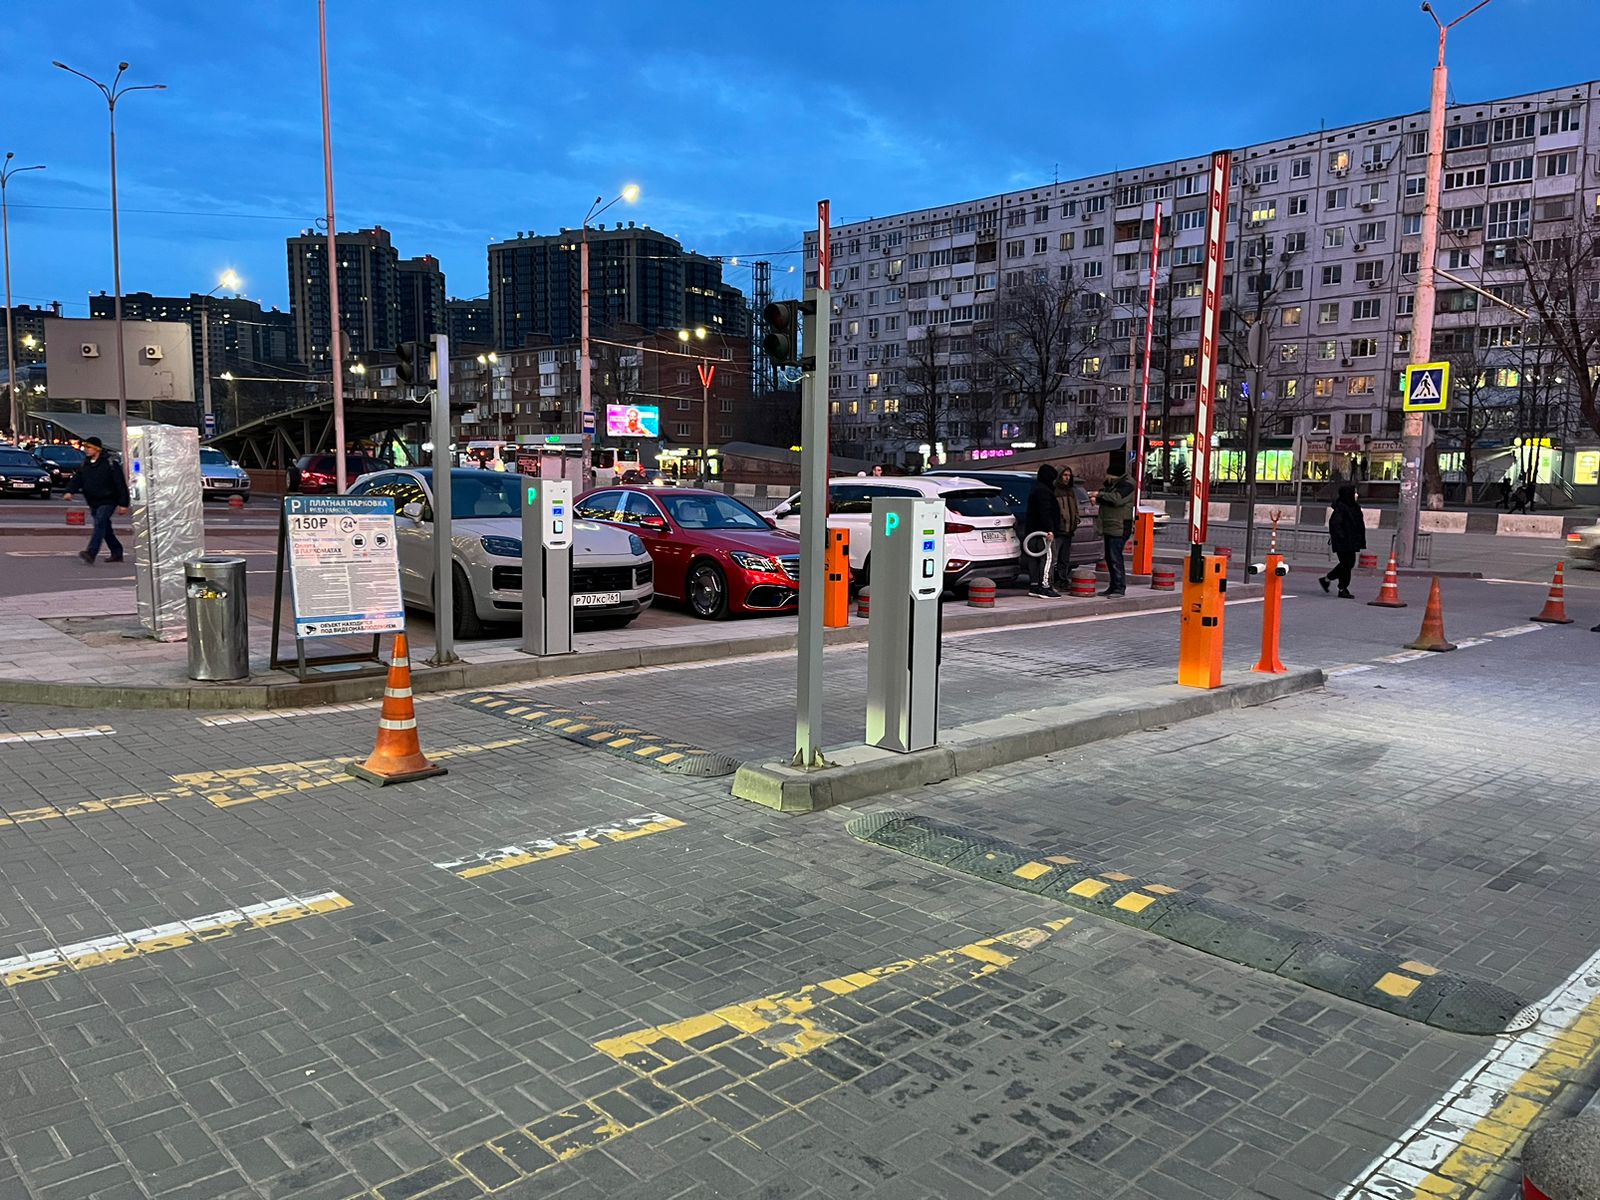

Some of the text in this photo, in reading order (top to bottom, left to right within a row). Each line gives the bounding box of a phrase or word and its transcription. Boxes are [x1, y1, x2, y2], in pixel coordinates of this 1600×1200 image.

[527, 487, 537, 506] P
[291, 500, 301, 513] P
[885, 512, 900, 537] P
